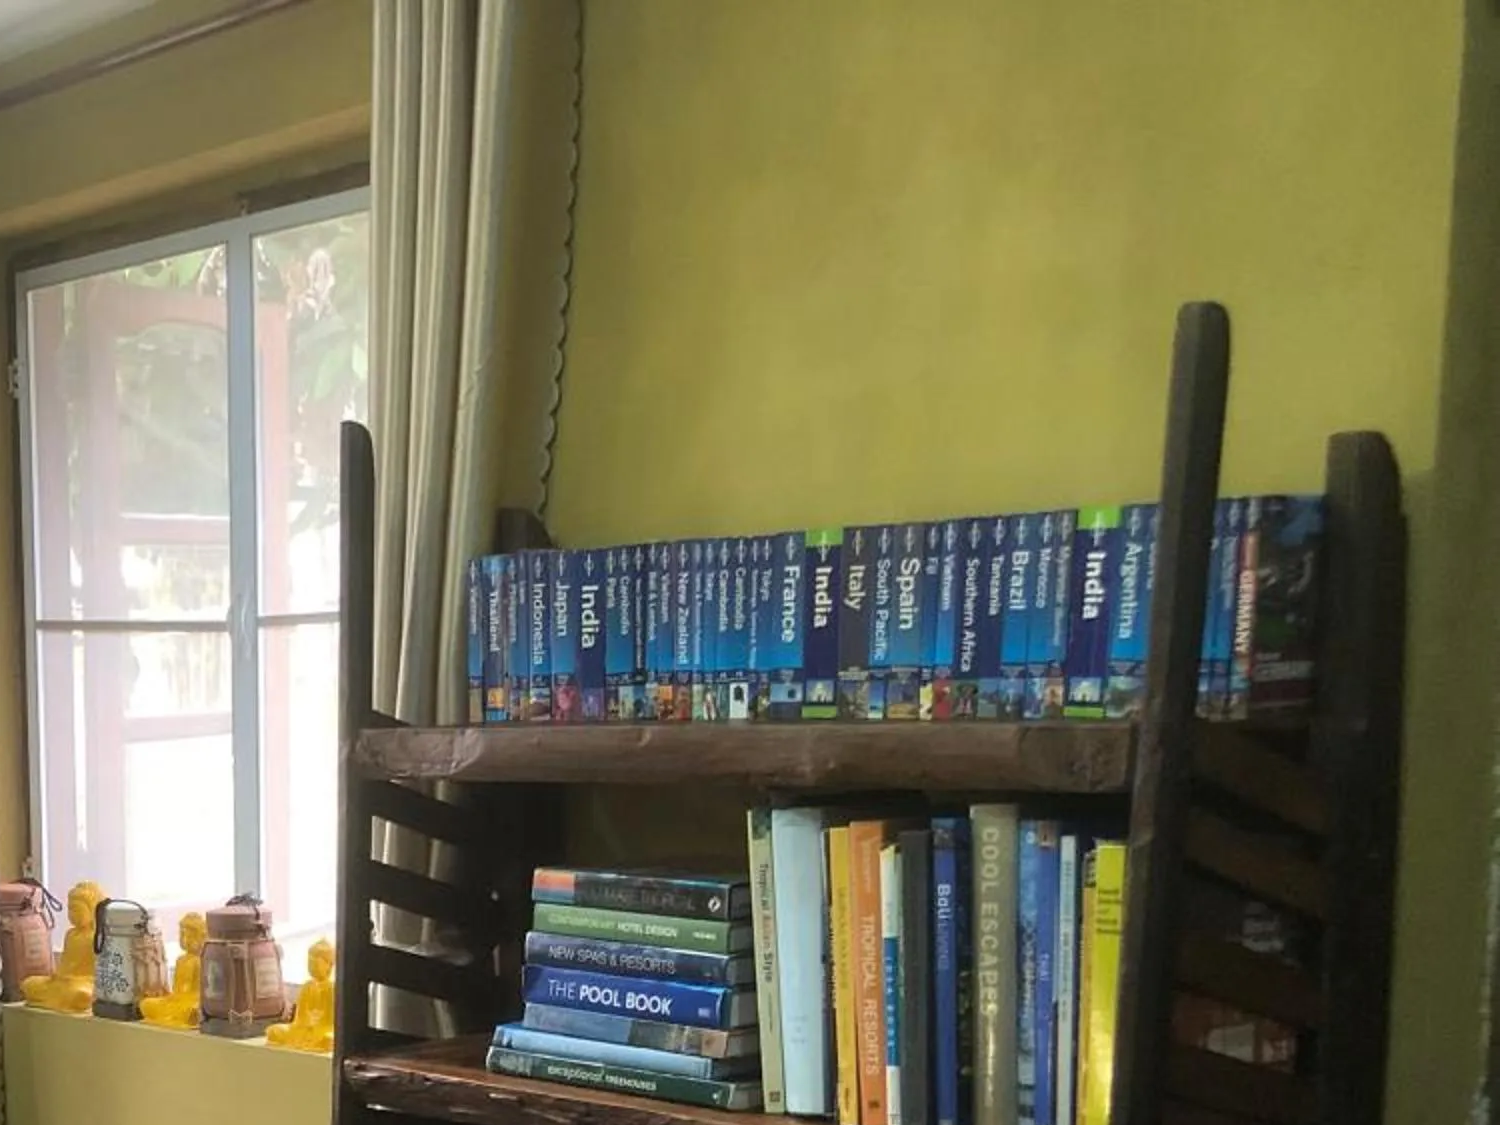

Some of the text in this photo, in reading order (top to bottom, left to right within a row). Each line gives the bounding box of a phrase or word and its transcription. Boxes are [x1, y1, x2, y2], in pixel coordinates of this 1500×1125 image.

[554, 578, 573, 638] Japan
[718, 569, 730, 633] Cambodia
[733, 567, 747, 632] Cambodia
[780, 564, 802, 645] France
[812, 566, 834, 630] India
[843, 564, 867, 612] Italy
[872, 558, 892, 662] South Pacific
[895, 557, 922, 632] Spain
[940, 553, 956, 612] Vietnam
[987, 553, 1006, 617] Tanzania
[1008, 550, 1031, 611] Brazil
[1035, 547, 1054, 610] Morocco
[1080, 551, 1108, 621] India
[1116, 541, 1144, 641] Argentina
[531, 582, 547, 665] Indonesia
[580, 584, 601, 649] India
[676, 571, 690, 665] New Zealand
[959, 559, 981, 673] Southern Africa
[1234, 569, 1258, 655] GERMANY
[934, 883, 953, 922] Bali
[977, 826, 1001, 1017] COOL ESCAPES
[548, 945, 575, 961] NEW
[576, 947, 607, 967] SPAS
[618, 954, 677, 975] RESORTS
[762, 950, 776, 984] Style
[860, 913, 879, 990] TROPICAL
[547, 979, 676, 1017] THE POOL BOOK
[862, 998, 882, 1076] RESORTS
